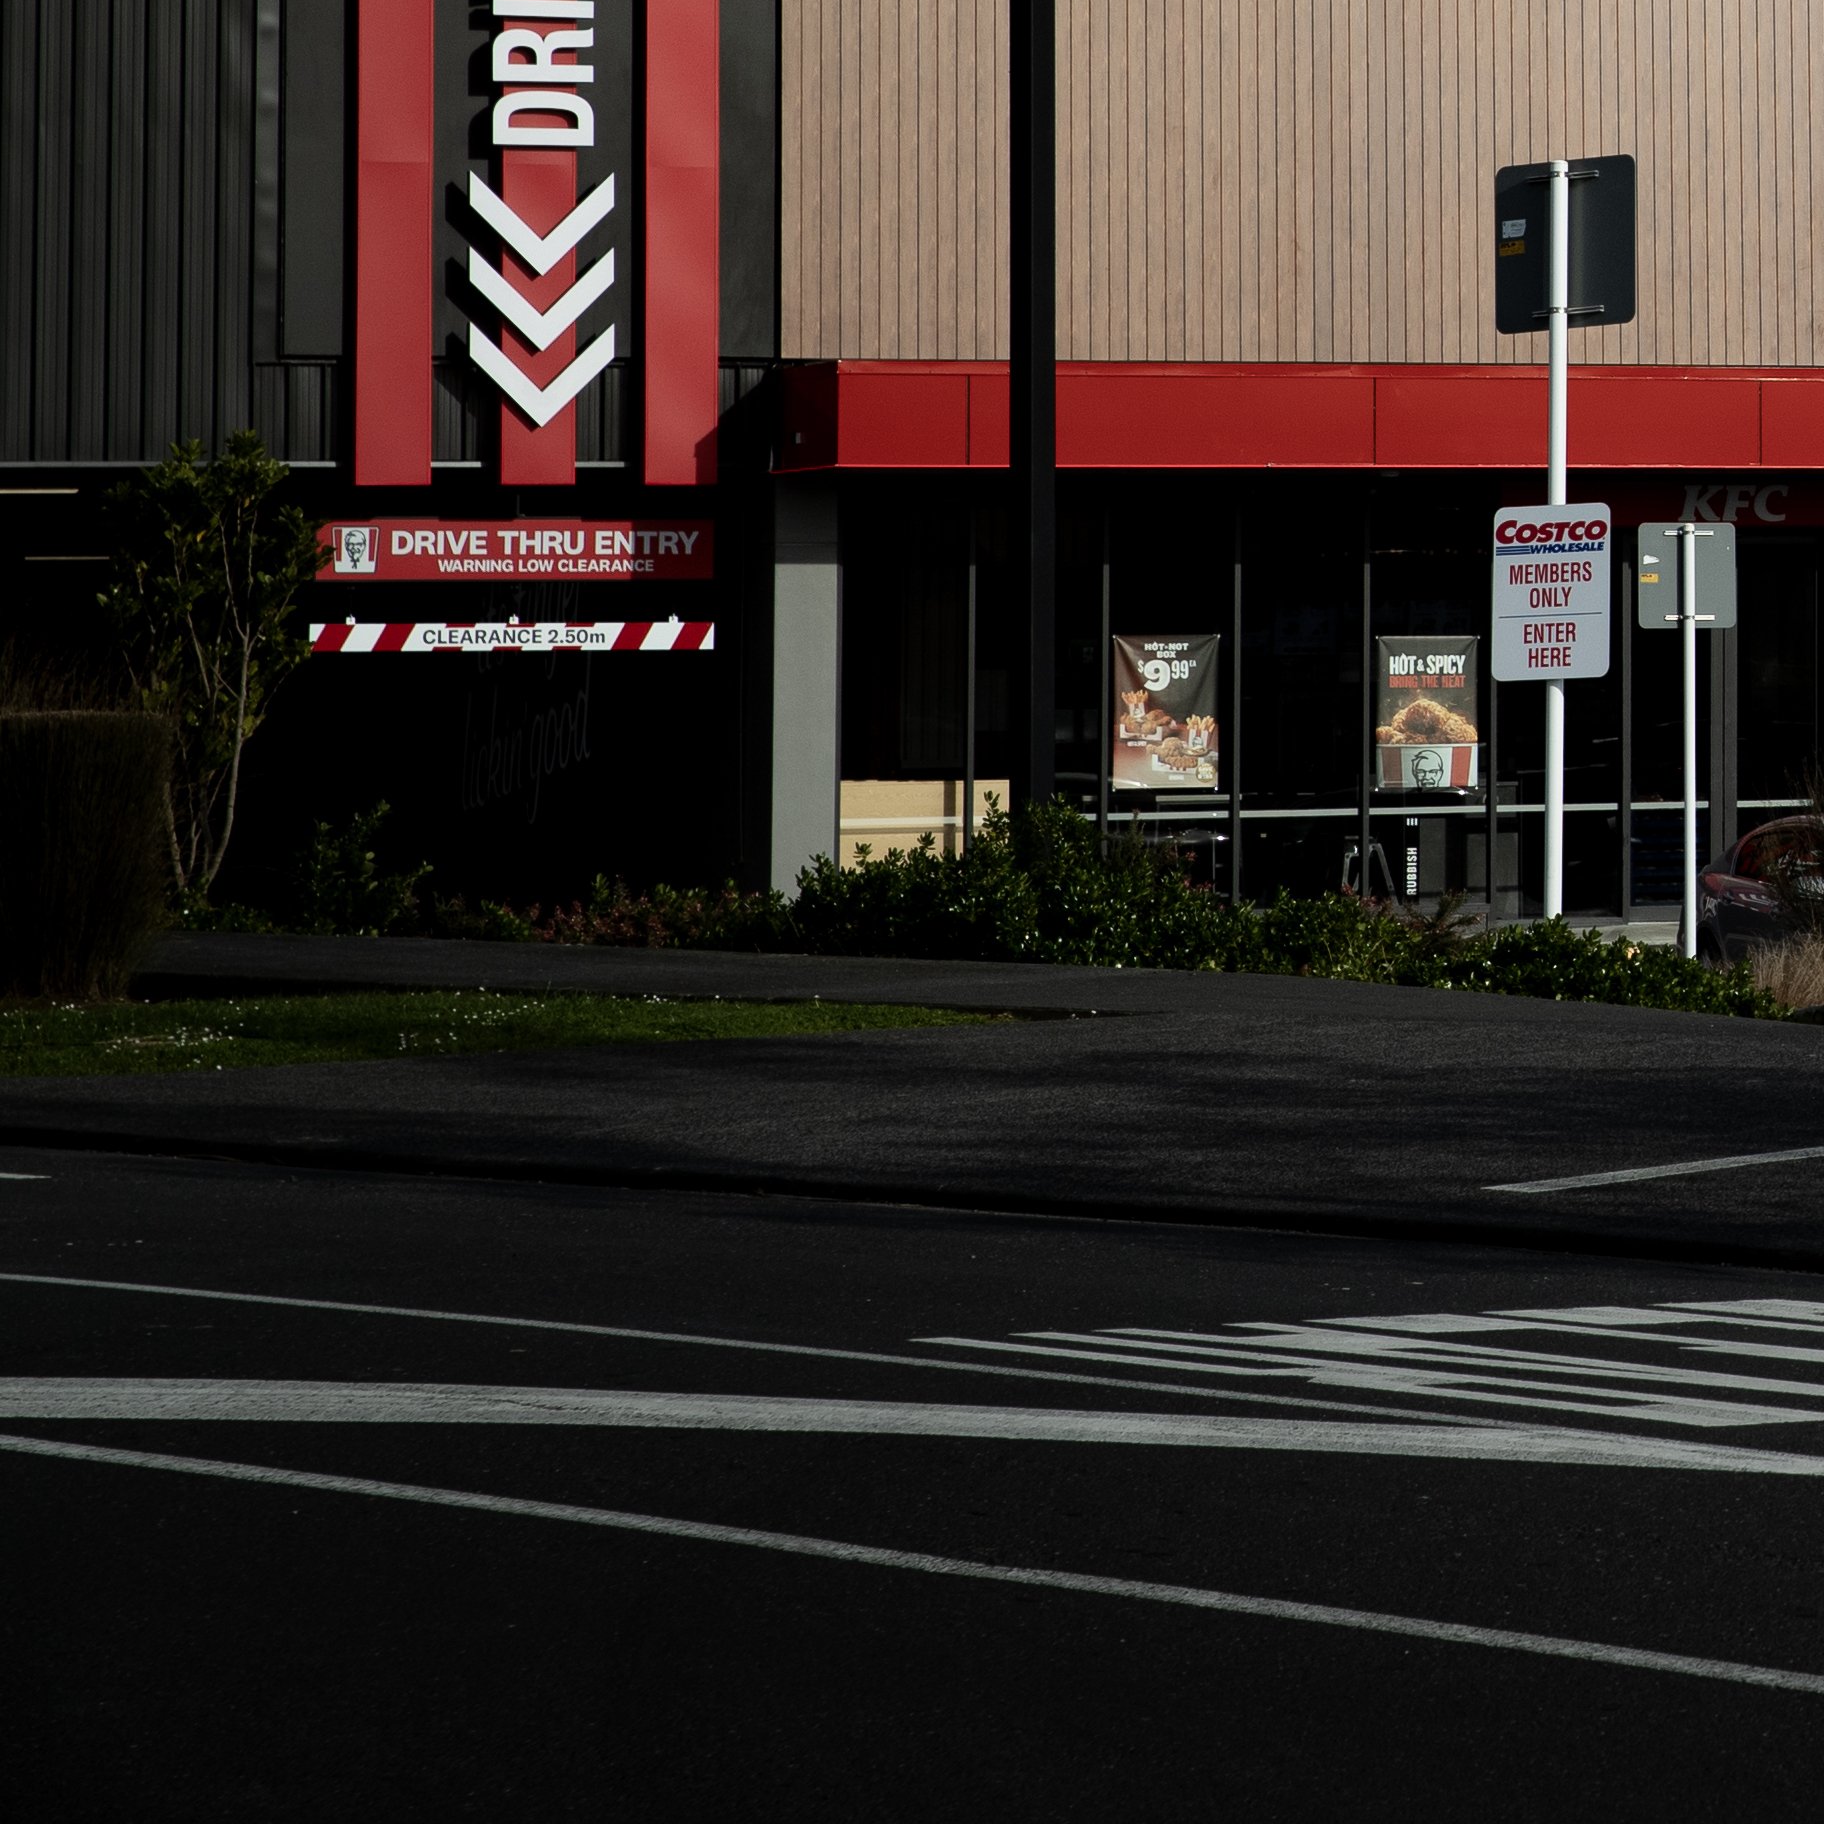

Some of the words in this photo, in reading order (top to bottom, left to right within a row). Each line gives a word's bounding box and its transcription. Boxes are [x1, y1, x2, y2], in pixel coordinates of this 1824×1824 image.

[1677, 483, 1791, 523] KFC
[391, 530, 488, 556] DRIVE
[497, 530, 585, 556] THRU
[594, 529, 700, 556] ENTRY
[1495, 519, 1608, 545] COSTCO
[1529, 541, 1604, 555] WHOLESALE
[437, 558, 514, 573] WARNING
[518, 558, 554, 573] LOW
[557, 558, 655, 573] CLEARANCE
[1509, 560, 1593, 585] MEMBERS
[1529, 586, 1572, 609] ONLY
[422, 629, 543, 645] CLEARANCE
[547, 629, 606, 645] 2.50m
[1523, 621, 1576, 645] ENTER
[1417, 658, 1425, 672] &
[1426, 654, 1467, 675] SPICY
[1528, 646, 1571, 669] HERE
[1389, 675, 1418, 688] BRING
[1421, 675, 1439, 688] THE
[1442, 674, 1467, 688] HEAT
[1405, 847, 1418, 896] RUBBISH
